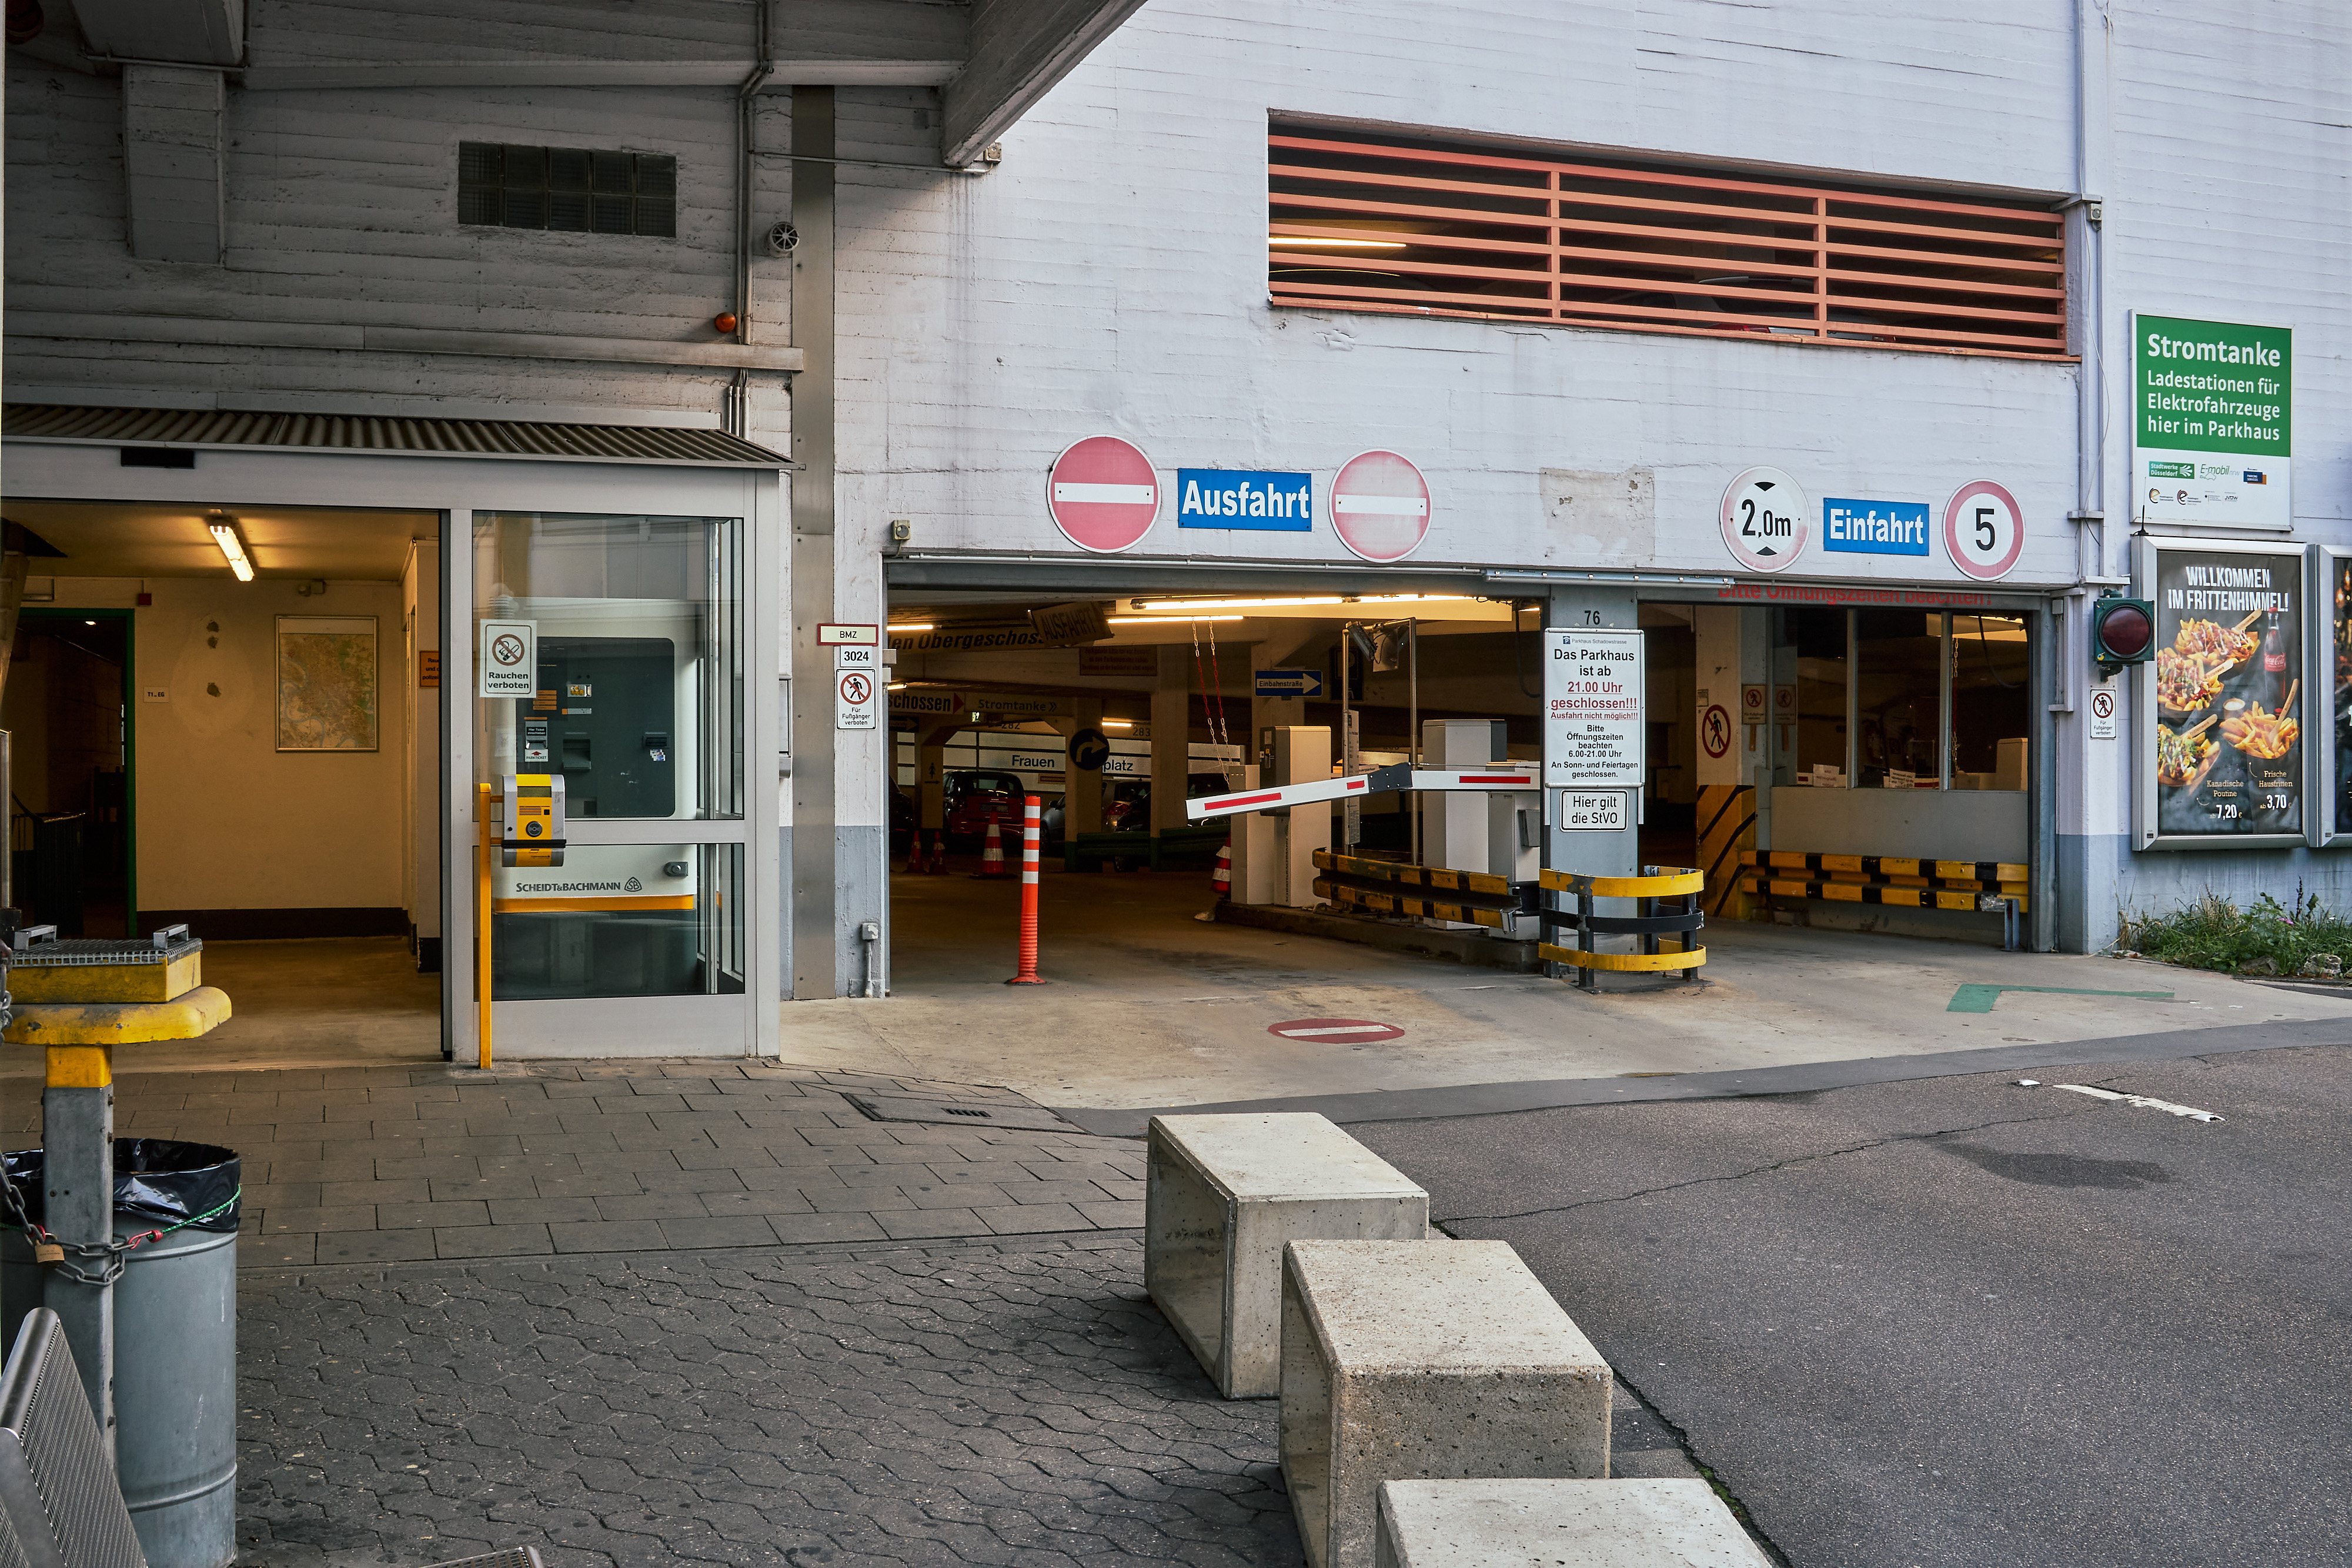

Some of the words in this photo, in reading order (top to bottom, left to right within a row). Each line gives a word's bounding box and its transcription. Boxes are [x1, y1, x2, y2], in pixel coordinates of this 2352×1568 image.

[2147, 333, 2280, 367] Stromtanke
[2147, 370, 2254, 393] Ladestationen
[2257, 377, 2280, 395] für
[2147, 393, 2280, 421] Elektrofahrzeuge
[2147, 414, 2180, 433] hier
[2184, 417, 2203, 435] im
[2209, 420, 2280, 440] Parkhaus
[1181, 480, 1309, 519] Ausfahrt
[1741, 499, 1791, 538] 2,0m
[1830, 508, 1924, 544] Einfahrt
[1975, 508, 1995, 551] 5
[2185, 566, 2270, 589] WILLKOMMEN
[2168, 589, 2184, 609] IM
[2187, 590, 2288, 612] FRITTENHIMMEL!
[1042, 610, 1097, 640] AUSFAHRT
[1584, 610, 1600, 625] 76
[844, 651, 869, 661] 3024
[1554, 648, 1577, 660] Das
[1581, 649, 1635, 661] Parkhaus
[1579, 665, 1594, 676] ist
[1597, 665, 1611, 676] ab
[1567, 681, 1598, 693] 21.00
[1602, 681, 1623, 693] Uhr
[888, 691, 951, 711] schossen
[978, 699, 1046, 711] Stromtanke
[1551, 697, 1637, 711] geschlossen!!!
[1604, 712, 1638, 720] möglich!!!
[1132, 727, 1151, 737] 283
[1566, 731, 1623, 742] Öffnungszeiten
[1012, 754, 1055, 768] Frauen
[1103, 760, 1133, 772] platz
[1602, 761, 1638, 770] Feiertagen
[1572, 771, 1618, 779] geschlossen.
[1573, 795, 1597, 807] Hier
[1600, 796, 1617, 810] gilt
[2266, 794, 2287, 811] 3,70
[1572, 812, 1588, 824] die
[1591, 812, 1618, 824] StVO
[2216, 804, 2237, 820] 7,20
